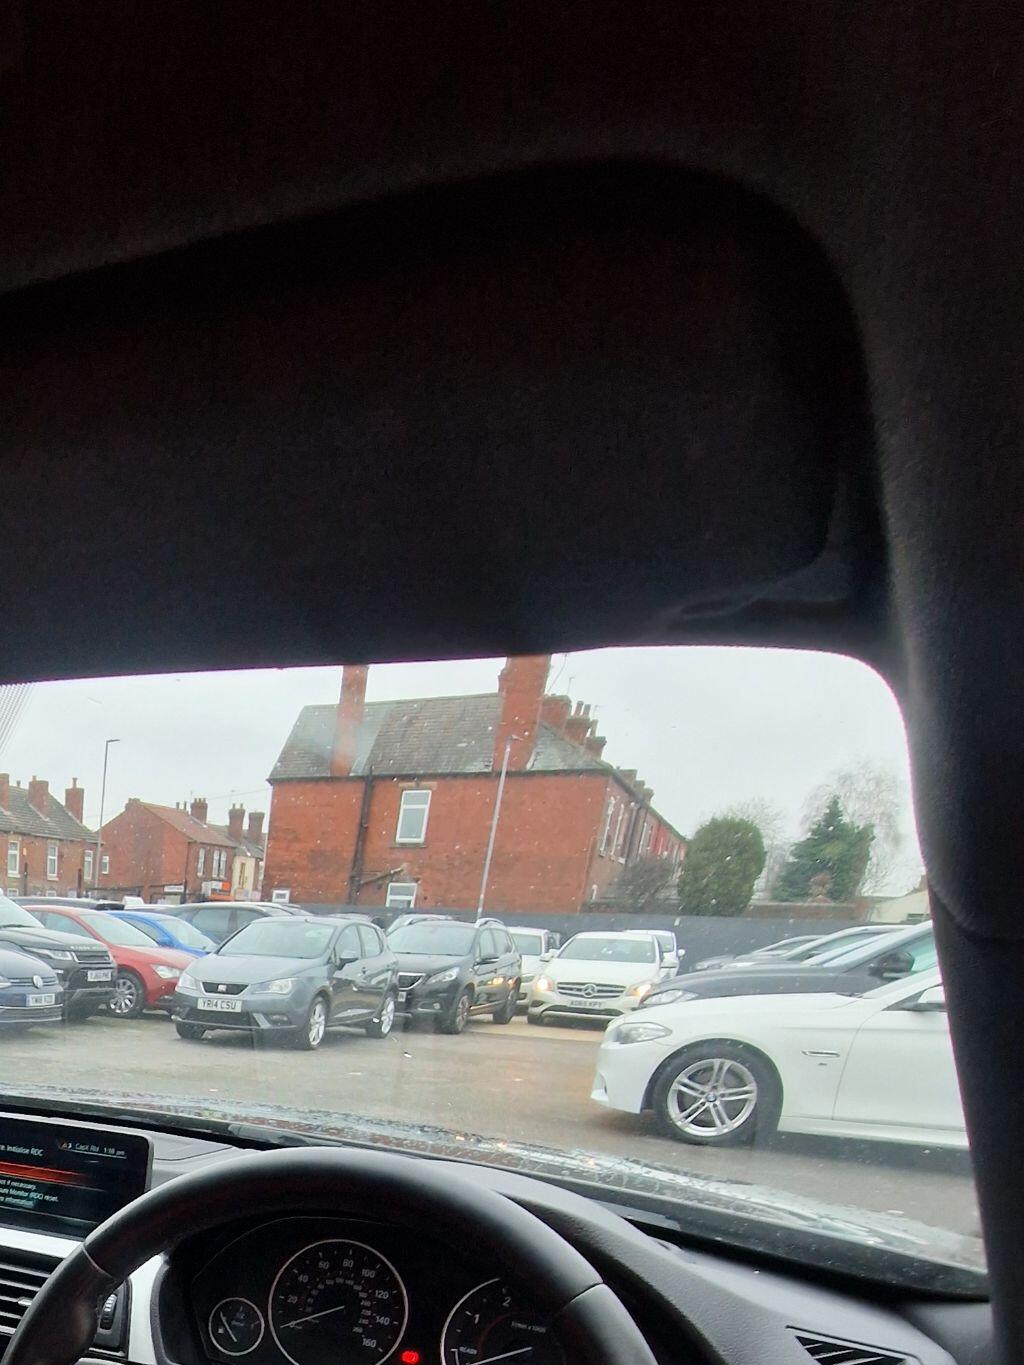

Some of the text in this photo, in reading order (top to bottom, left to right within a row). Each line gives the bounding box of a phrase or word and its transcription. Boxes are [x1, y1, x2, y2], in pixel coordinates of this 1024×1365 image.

[202, 999, 237, 1010] YR14 CSU
[361, 1269, 376, 1279] 100
[375, 1289, 390, 1300] 120
[502, 1296, 512, 1308] 2
[375, 1315, 390, 1326] 140
[473, 1313, 481, 1325] 1
[361, 1337, 377, 1348] 160
